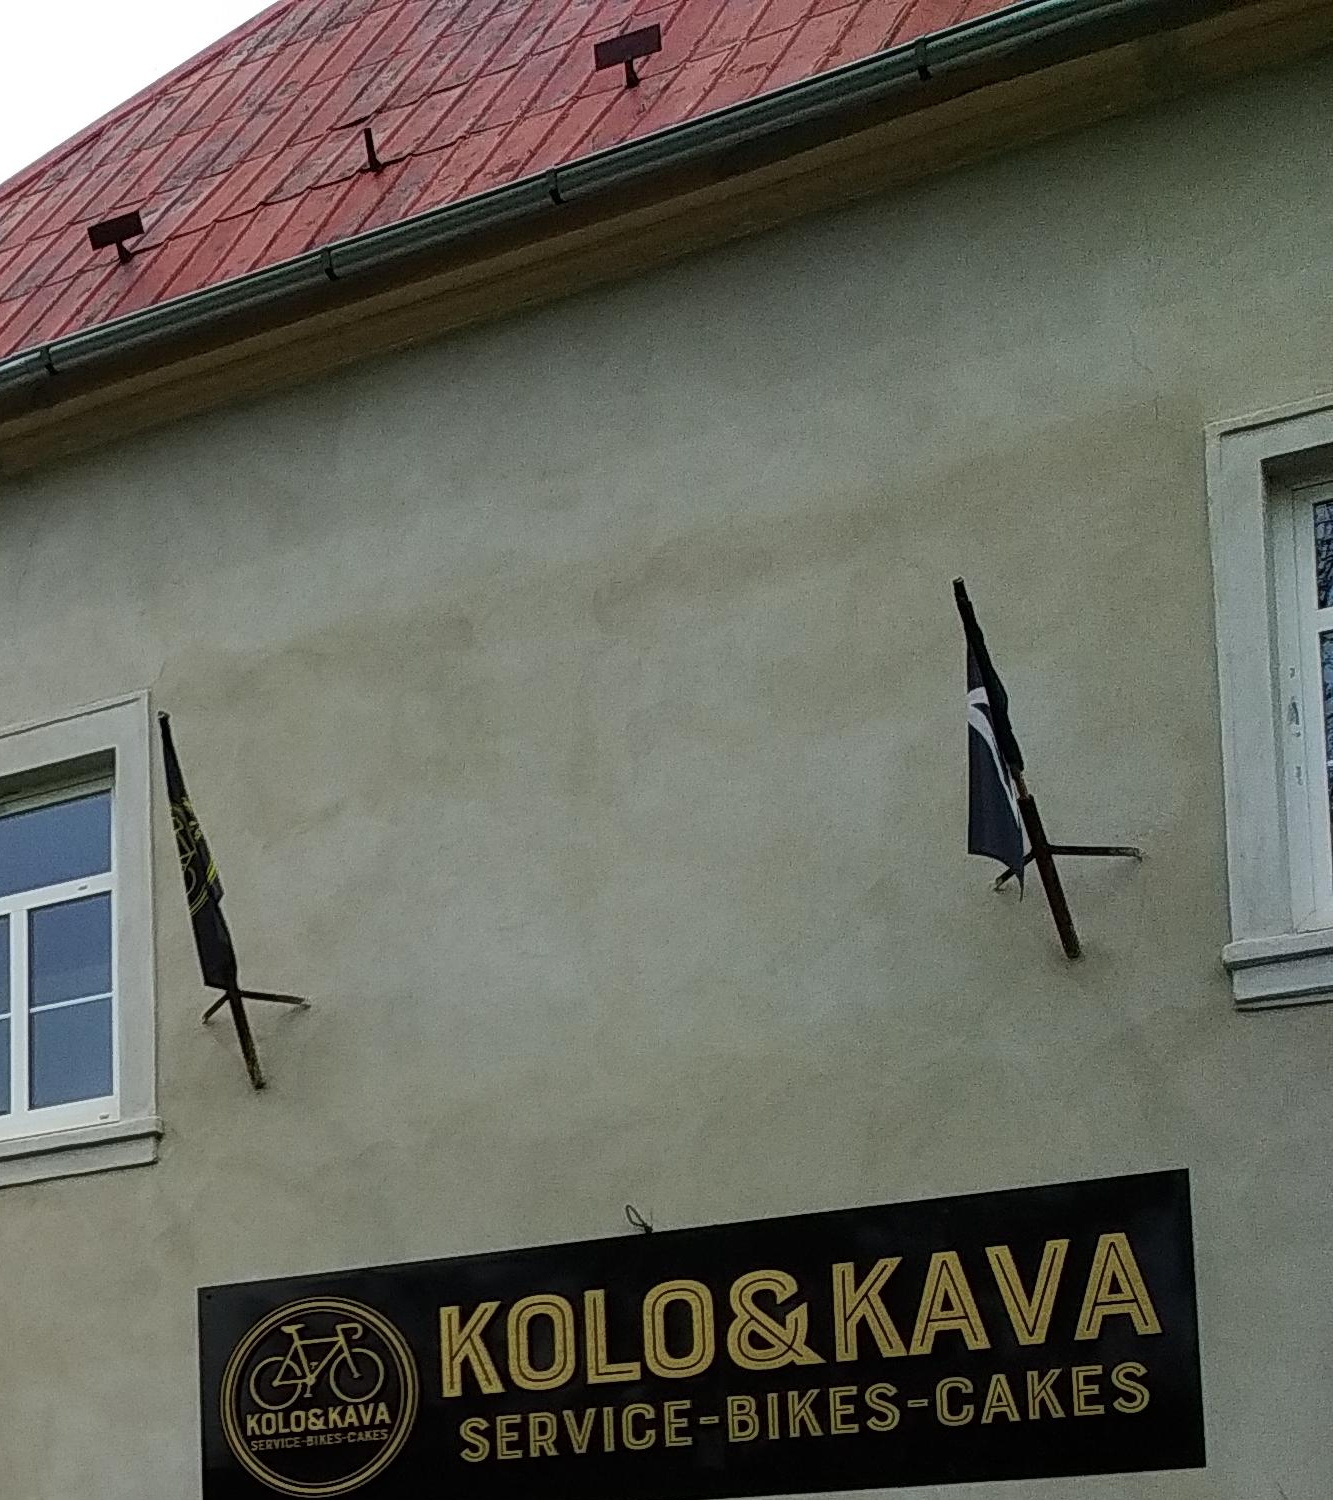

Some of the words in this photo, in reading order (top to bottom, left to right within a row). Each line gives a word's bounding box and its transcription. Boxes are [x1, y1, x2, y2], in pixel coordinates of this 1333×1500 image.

[439, 1232, 1163, 1398] KOLO&KAVA
[246, 1401, 392, 1436] KOLO&KAVA
[249, 1429, 389, 1451] SERVICE-BIKES-CAKES
[458, 1360, 1151, 1464] SERVICE-BIKES-CAKES
